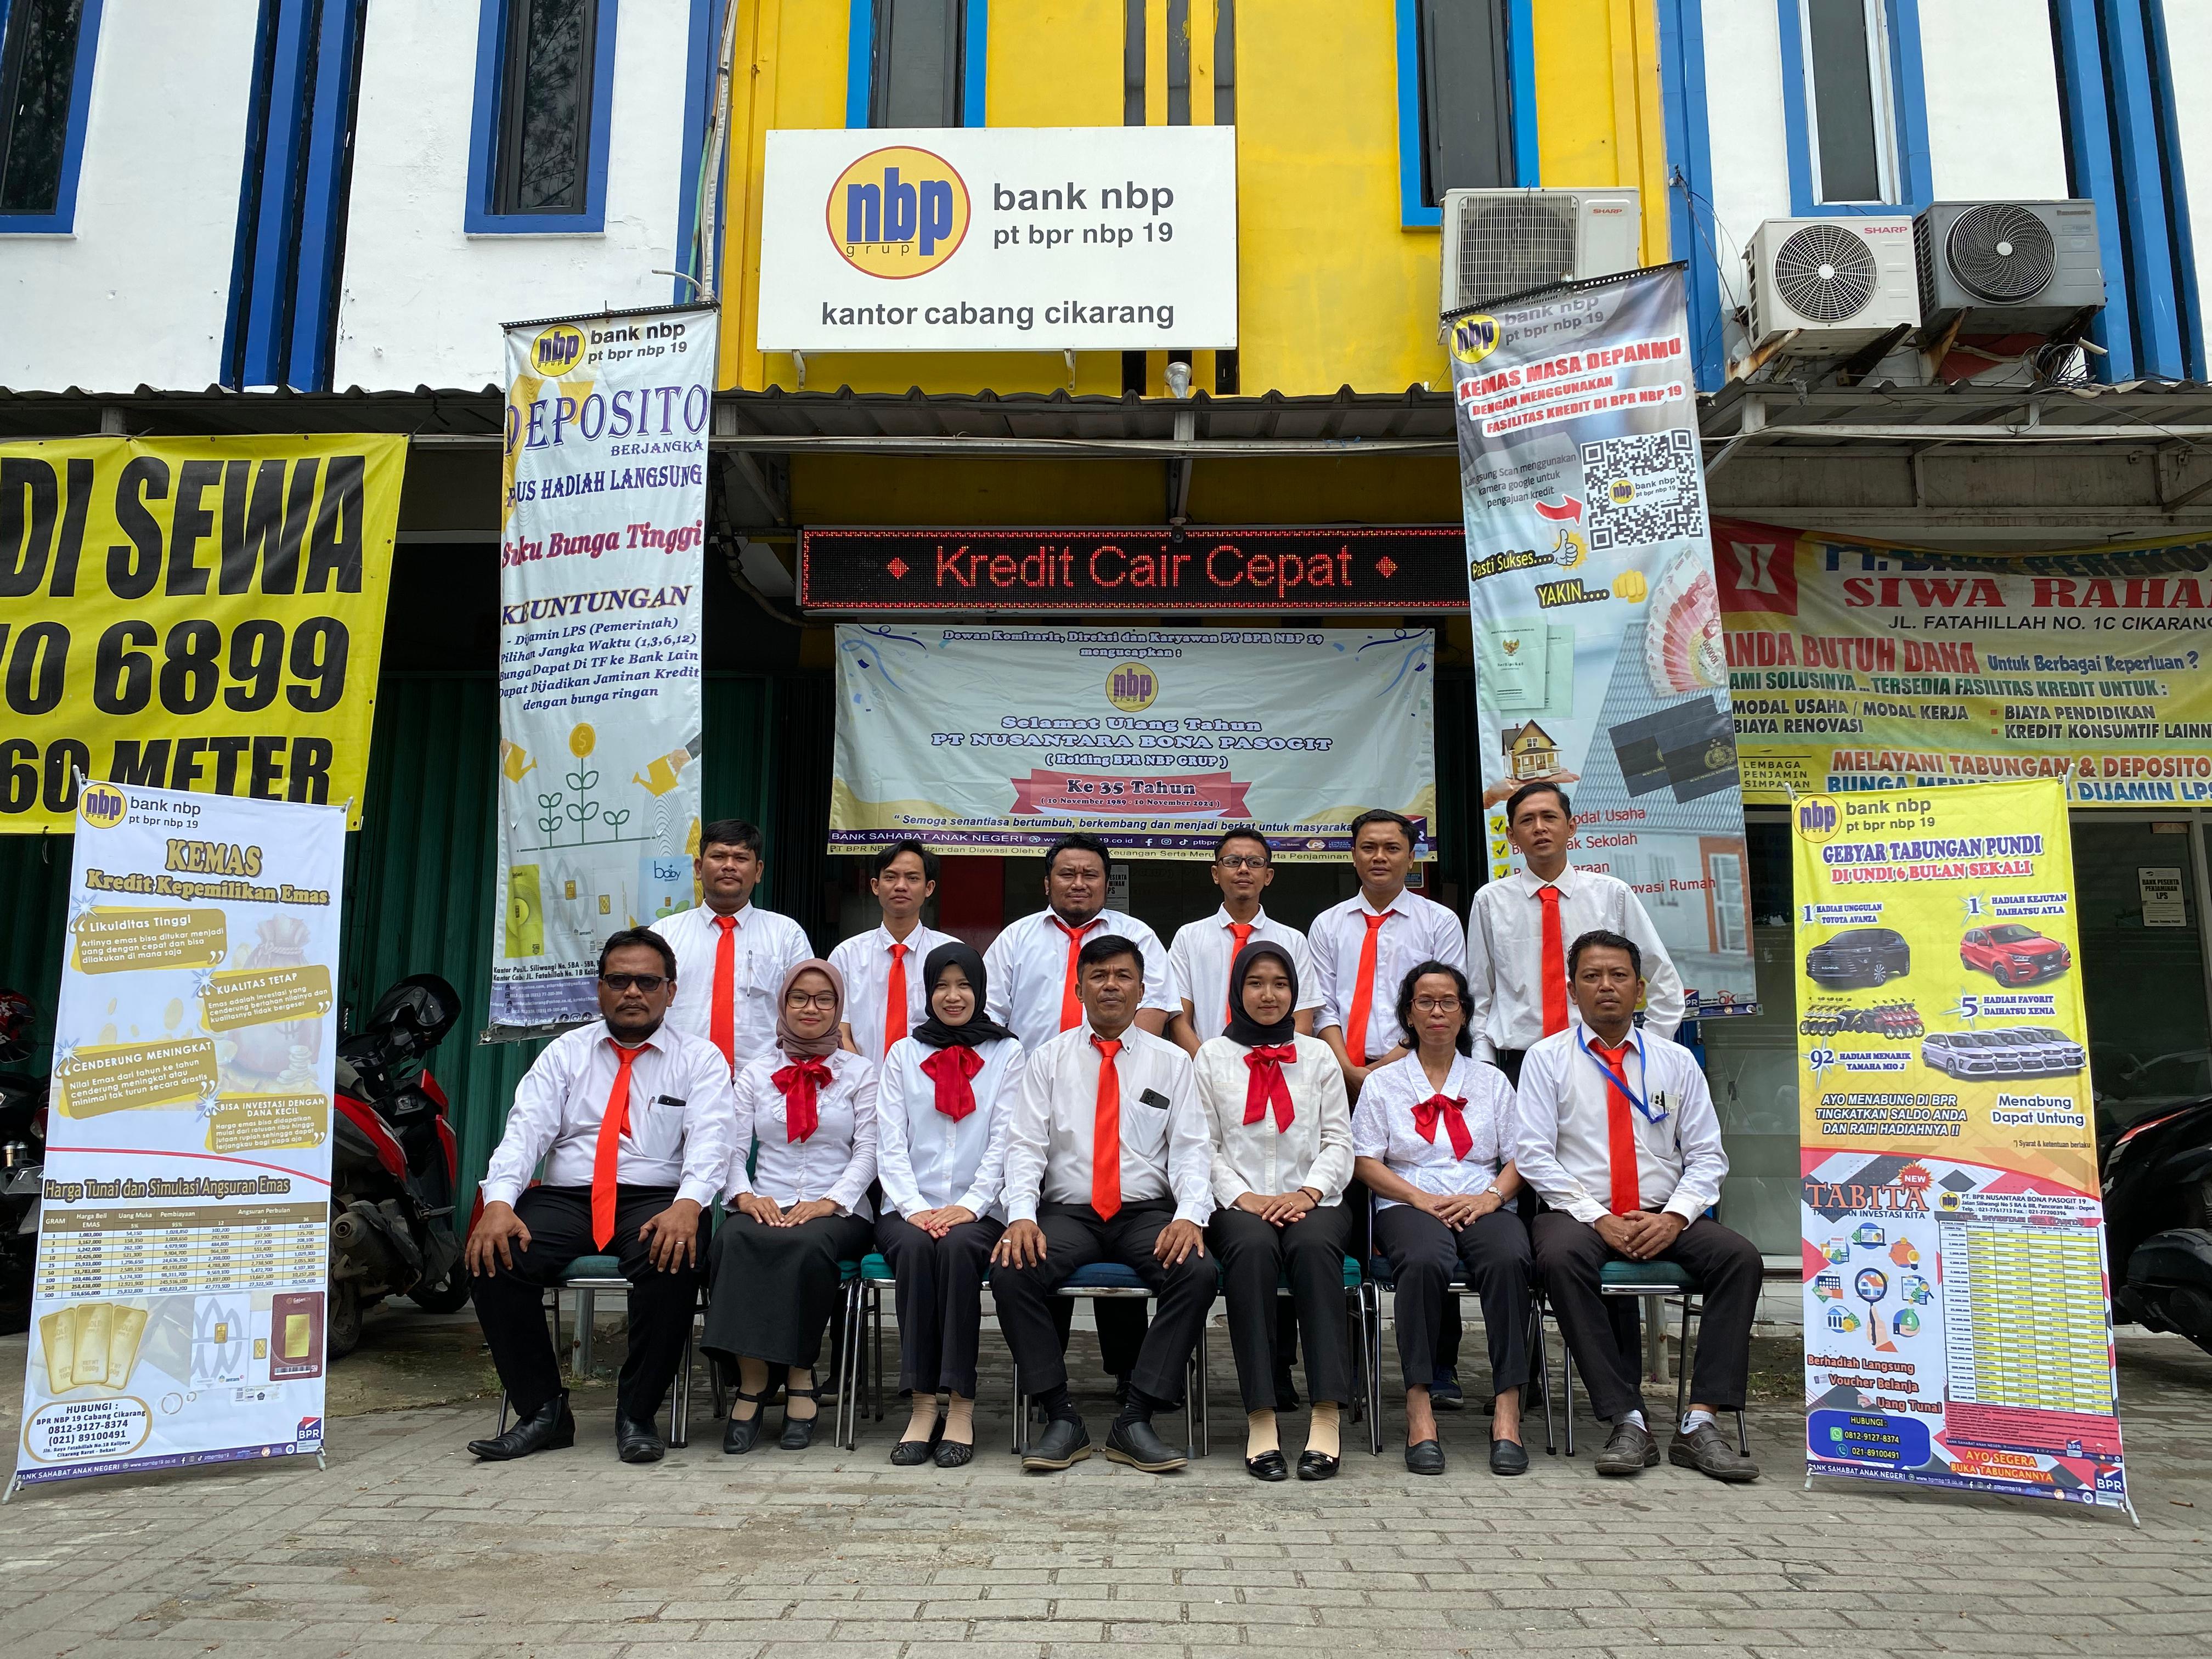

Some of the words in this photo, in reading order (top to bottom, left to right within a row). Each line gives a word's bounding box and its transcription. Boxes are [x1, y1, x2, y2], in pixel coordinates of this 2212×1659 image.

[994, 182, 1087, 211] bank
[1102, 182, 1174, 215] nbp
[847, 167, 953, 256] nbp
[994, 224, 1020, 249] pt
[1029, 224, 1074, 248] bpr
[1082, 224, 1133, 248] nbp
[1143, 223, 1172, 242] 19
[845, 244, 910, 257] grup
[822, 303, 917, 325] kantor
[924, 302, 1034, 330] cabang
[1045, 301, 1174, 329] cikarang
[591, 326, 640, 345] bank
[647, 323, 685, 340] nbp
[1524, 324, 1550, 341] bpr
[589, 352, 603, 364] pt
[608, 349, 633, 360] bpr
[637, 347, 665, 358] nbp
[671, 342, 687, 353] 19
[1461, 370, 1521, 400] KEMAS
[1526, 356, 1581, 383] MASA
[1587, 337, 1681, 370] DEPANMU
[1472, 398, 1517, 416] DENGAN
[1521, 376, 1613, 407] MENGGUNAKAN
[1487, 408, 1544, 434] FASILITAS
[1547, 399, 1591, 420] KREDIT
[1611, 393, 1636, 408] BPR
[1639, 390, 1665, 403] NBP
[1667, 385, 1682, 397] 19
[505, 384, 710, 455] DEPOSITO
[611, 440, 704, 456] BERJANGKA
[541, 471, 605, 499] HADIAH
[610, 464, 702, 490] LANGSUNG
[106, 456, 365, 600] SEWA
[546, 532, 620, 559] Bunga
[627, 520, 702, 554] Tinggi
[936, 546, 1074, 587] Kredit
[1090, 546, 1190, 587] Cair
[1207, 545, 1352, 597] Cepat
[1843, 578, 2005, 607] SIWA
[562, 625, 585, 637] LPS
[590, 617, 678, 635] (Pemerintah)
[2052, 617, 2085, 629] NO.
[589, 639, 630, 650] Waktu
[944, 631, 990, 641] Dewan
[992, 631, 1064, 643] Komisaris,
[1068, 633, 1119, 642] Direksi
[1150, 633, 1218, 645] Karyawan
[1243, 634, 1271, 644] BPR
[1274, 634, 1304, 644] NBP
[1802, 634, 1895, 672] BUTUH
[93, 616, 349, 715] 6899
[533, 663, 569, 676] Dapat
[628, 651, 663, 664] Bank
[1987, 655, 2030, 671] Untuk
[654, 667, 699, 680] Kredit
[1955, 680, 2034, 696] FASILITAS
[2036, 681, 2095, 696] KREDIT
[2100, 680, 2158, 696] UNTUK
[523, 699, 567, 711] dengan
[571, 692, 609, 704] bunga
[613, 687, 658, 700] ringan
[1863, 702, 1916, 718] MODAL
[1920, 706, 1968, 720] KERJA
[2005, 706, 2048, 720] BIAYA
[2056, 707, 2155, 720] PENDIDIKAN
[1001, 716, 1099, 730] Selamat
[1108, 718, 1178, 731] Ulang
[1184, 719, 1261, 731] Tahun
[1784, 719, 1863, 733] RENOVASI
[2005, 725, 2062, 738] KREDIT
[2068, 724, 2159, 738] KONSUMTIF
[932, 734, 964, 746] PT
[970, 734, 1133, 747] NUSANTARA
[1139, 737, 1212, 749] BONA
[1218, 738, 1333, 751] PASOGIT
[1056, 754, 1110, 765] Holding
[1112, 756, 1141, 765] BPR
[1131, 781, 1195, 795] Tahun
[131, 797, 168, 812] bank
[173, 802, 201, 816] nbp
[1605, 806, 1645, 821] Usaha
[1846, 802, 1889, 816] bank
[1896, 799, 1931, 815] nbp
[129, 815, 140, 824] pt
[143, 816, 160, 826] bpr
[163, 818, 183, 829] nbp
[186, 820, 198, 829] 19
[902, 815, 946, 826] Semoga
[950, 817, 1009, 826] senantiasa
[1846, 820, 1860, 833] pt
[1863, 820, 1885, 832] bpr
[1890, 819, 1915, 831] nbp
[1920, 817, 1936, 827] 19
[1587, 833, 1638, 848] Sekolah
[1822, 843, 1887, 864] GEBYAR
[1889, 838, 1983, 861] TABUNGAN
[1986, 835, 2042, 855] PUNDI
[165, 839, 262, 877] KEMAS
[1853, 867, 1894, 882] UNDI
[1910, 864, 1966, 880] BULAN
[1969, 860, 2032, 877] SEKALI
[86, 869, 155, 893] Kredit
[155, 877, 278, 903] Kepemilikan
[280, 885, 329, 905] Emas
[1669, 877, 1716, 891] Rumah
[147, 1042, 211, 1060] MENINGKAT
[242, 1100, 285, 1109] INVESTASI
[288, 1098, 324, 1107] DENGAN
[1821, 1094, 1844, 1105] AYO
[1932, 1095, 1957, 1106] BPR
[1999, 1096, 2072, 1109] Menabung
[275, 1107, 298, 1115] KECIL
[1816, 1109, 1887, 1120] TINGKATKAN
[1890, 1109, 1931, 1120] SALDO
[1993, 1111, 2033, 1124] Dapat
[2036, 1112, 2084, 1126] Untung
[1822, 1124, 1846, 1134] DAN
[1849, 1124, 1877, 1135] RAIH
[1880, 1124, 1948, 1136] HADIAHNYA
[84, 1178, 120, 1199] Tunai
[148, 1177, 200, 1197] Simulasi
[201, 1177, 257, 1199] Angsuran
[258, 1176, 290, 1194] Emas
[1805, 1182, 1929, 1211] TABITA
[1807, 1355, 1859, 1368] Berhadiah
[1861, 1359, 1915, 1375] Langsung
[1830, 1374, 1875, 1387] Voucher
[1877, 1379, 1919, 1392] Belanja
[66, 1403, 112, 1414] HUBUNGI
[1908, 1401, 1942, 1414] Tunai
[48, 1420, 128, 1434] 0812-9127-8374
[298, 1428, 319, 1438] BPR
[78, 1430, 126, 1442] 89100491
[94, 1464, 120, 1473] NEGERI
[1881, 1471, 1905, 1479] NEGERI
[2097, 1479, 2121, 1491] BPR
